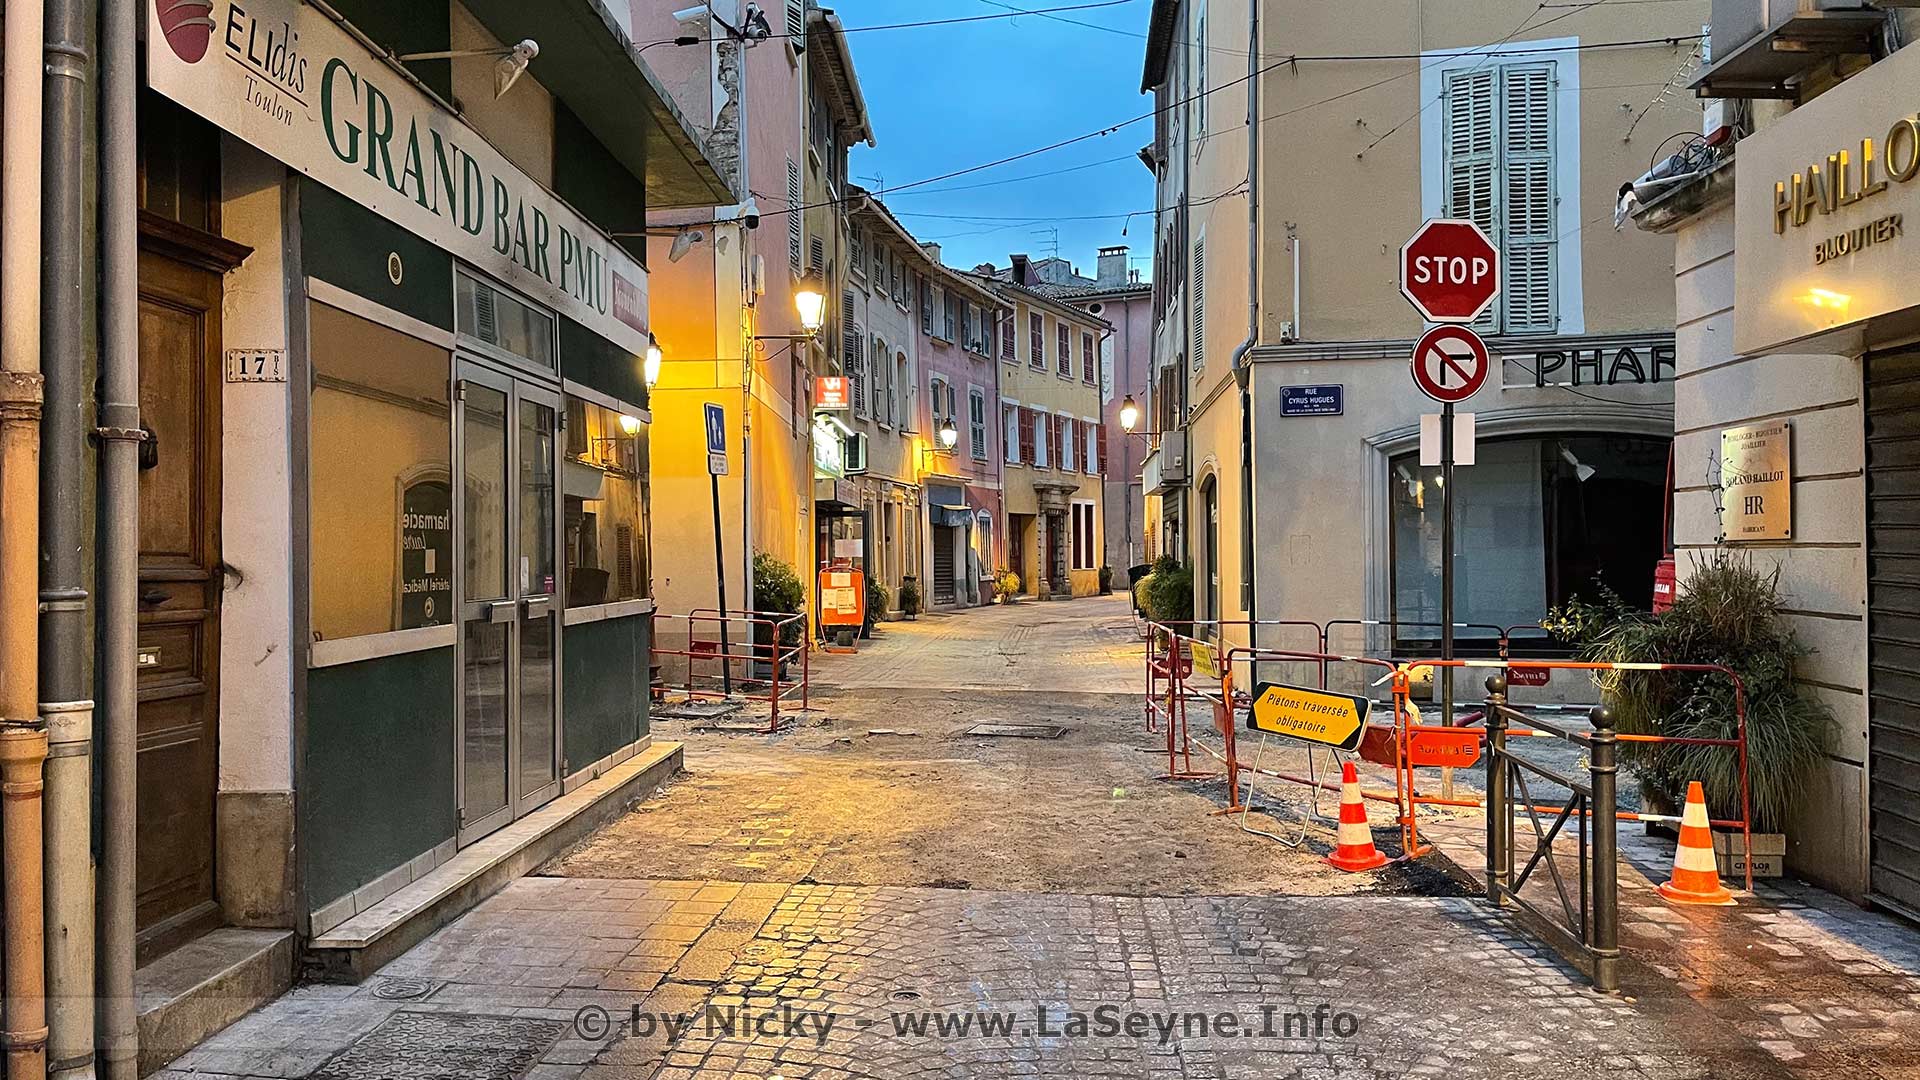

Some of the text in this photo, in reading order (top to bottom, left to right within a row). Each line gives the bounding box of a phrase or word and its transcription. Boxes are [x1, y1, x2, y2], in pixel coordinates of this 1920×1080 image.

[245, 75, 293, 126] Toulon
[321, 58, 485, 236] GRAND
[491, 174, 553, 284] BAR
[558, 224, 608, 315] PMU
[1773, 113, 1920, 235] HAILLO
[1815, 213, 1904, 266] BIJOUTIER
[1414, 255, 1489, 285] STOP
[240, 357, 265, 375] 17
[1288, 396, 1335, 405] CYRUS HUGUES
[1753, 470, 1785, 483] HAILLOT
[1744, 495, 1765, 515] HR
[1266, 693, 1349, 718] Piétons traversée
[1275, 715, 1327, 734] obligatoire
